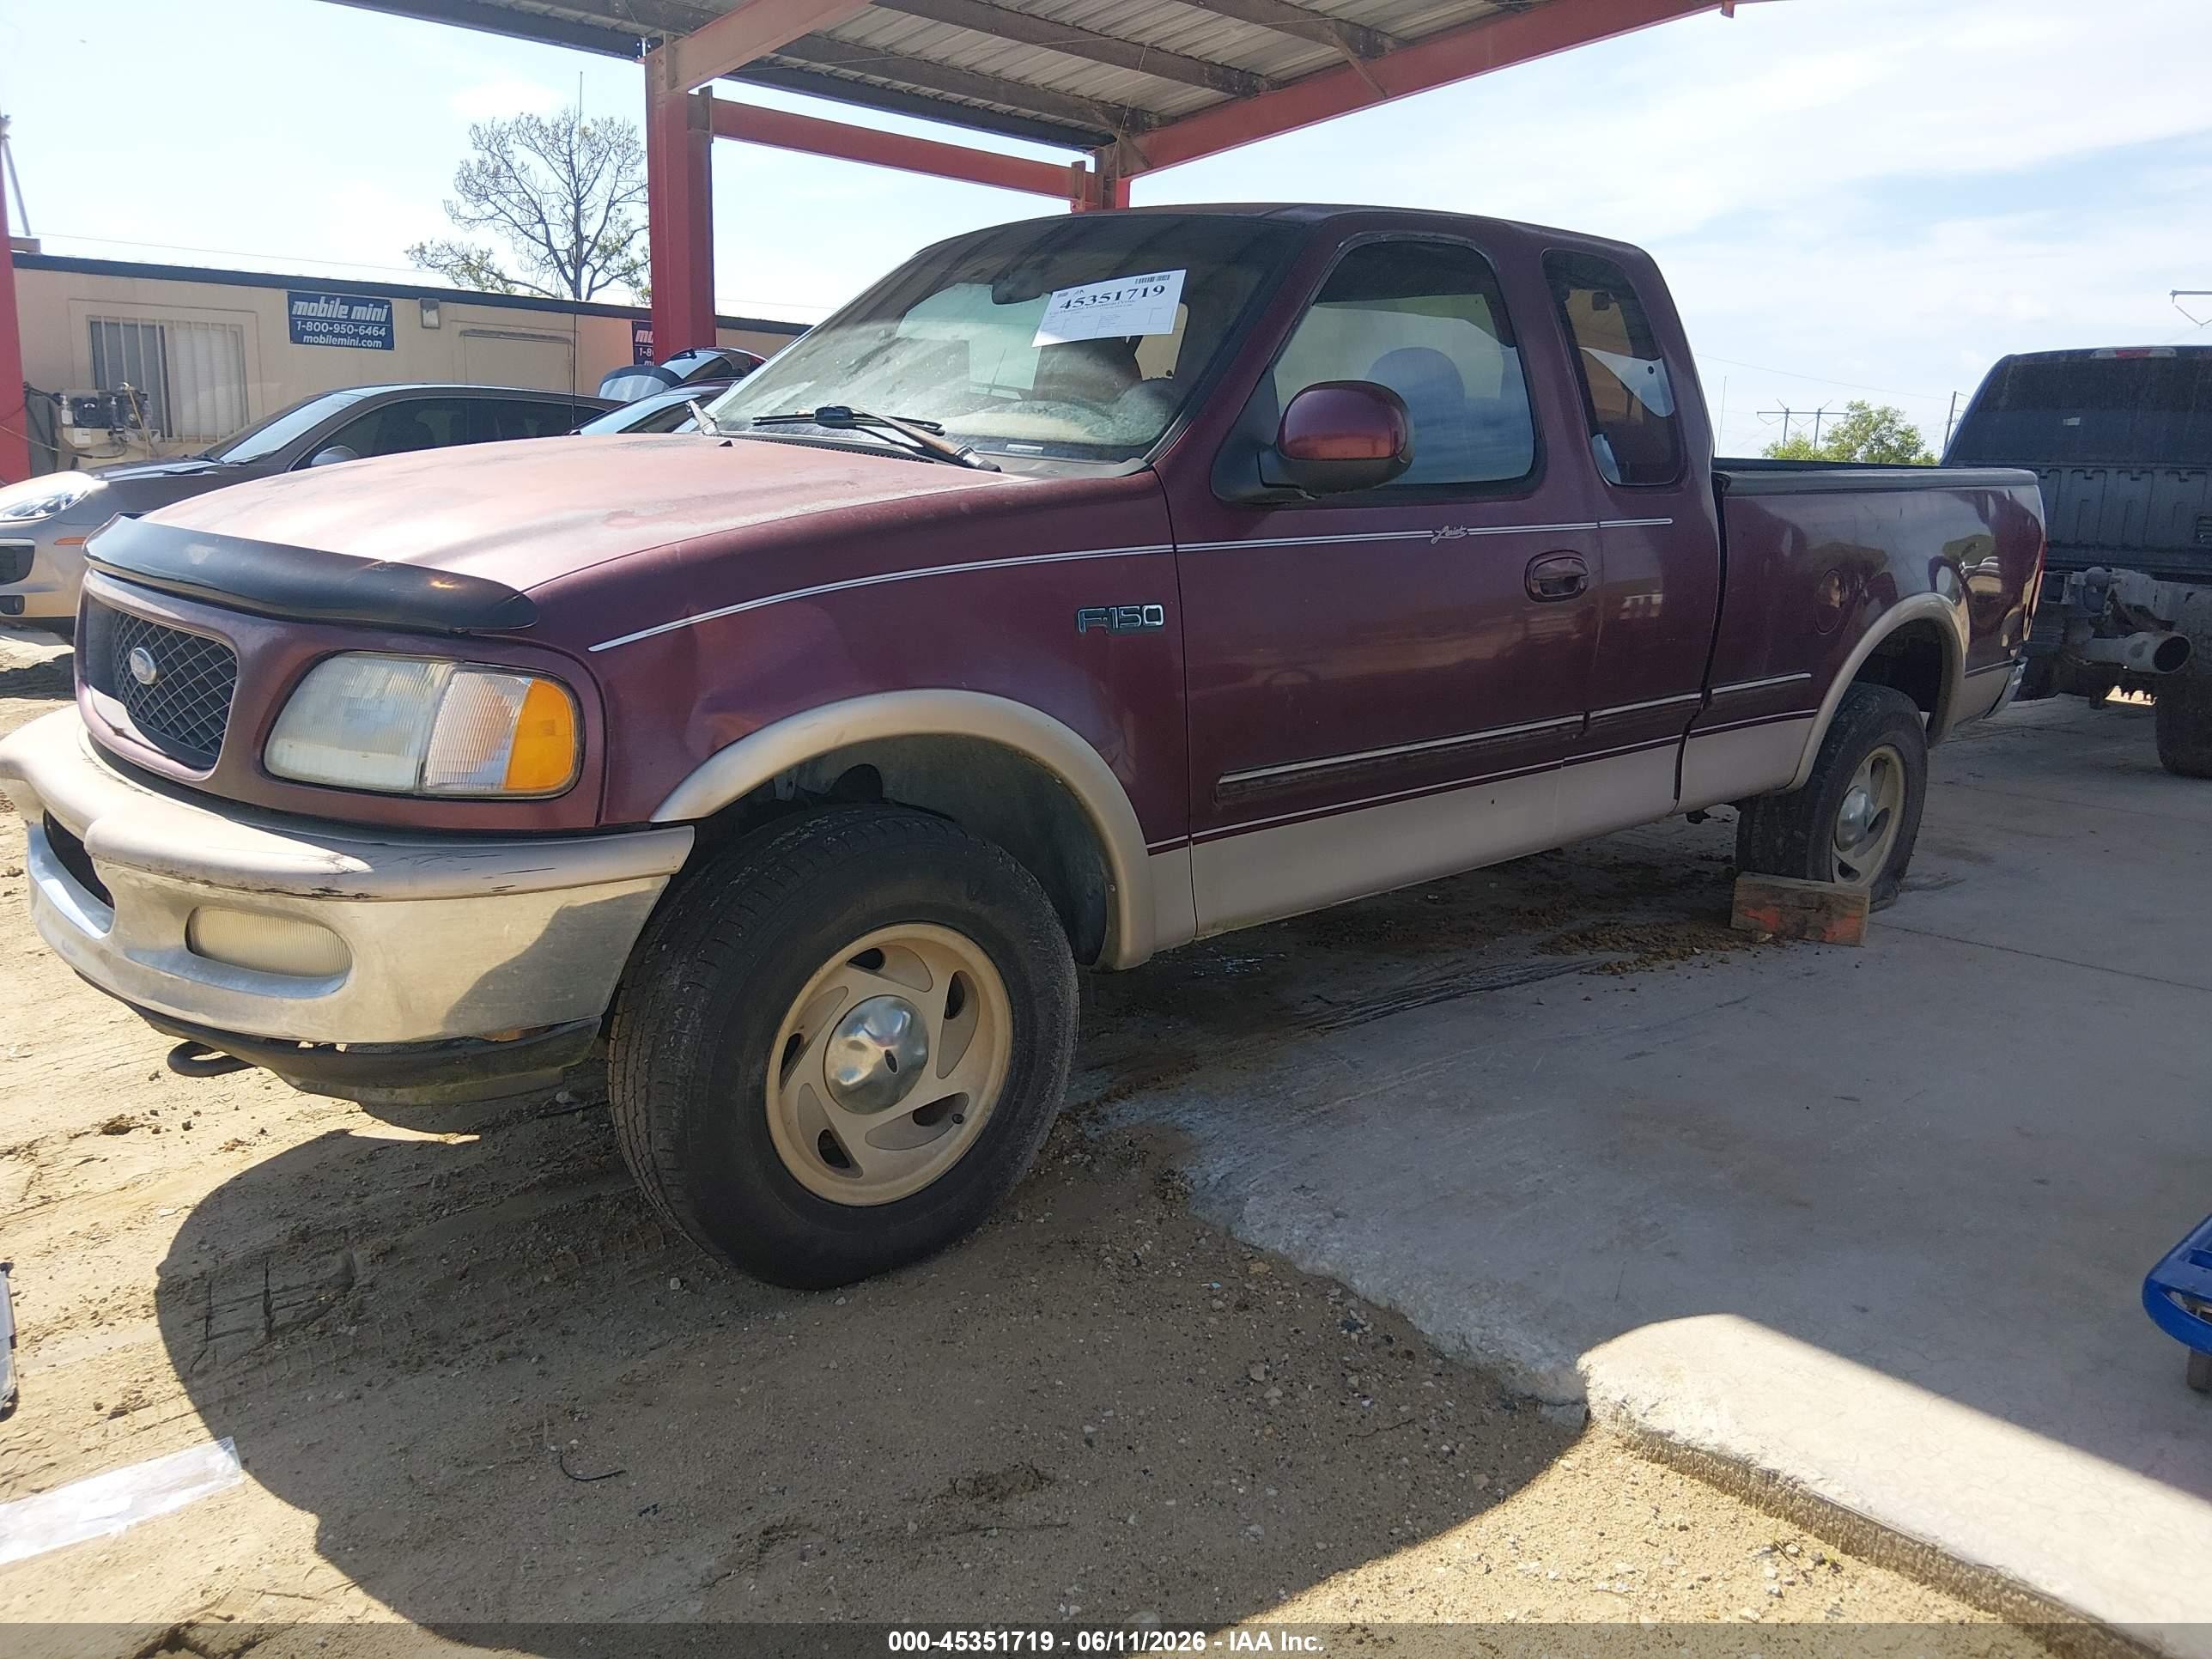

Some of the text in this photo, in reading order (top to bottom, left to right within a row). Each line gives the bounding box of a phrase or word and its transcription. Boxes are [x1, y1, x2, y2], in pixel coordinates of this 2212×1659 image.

[1060, 285, 1165, 309] 45351719
[292, 296, 390, 321] mobile mini
[296, 321, 386, 337] 1-800-950-6464
[303, 335, 382, 348] mobilemini.com
